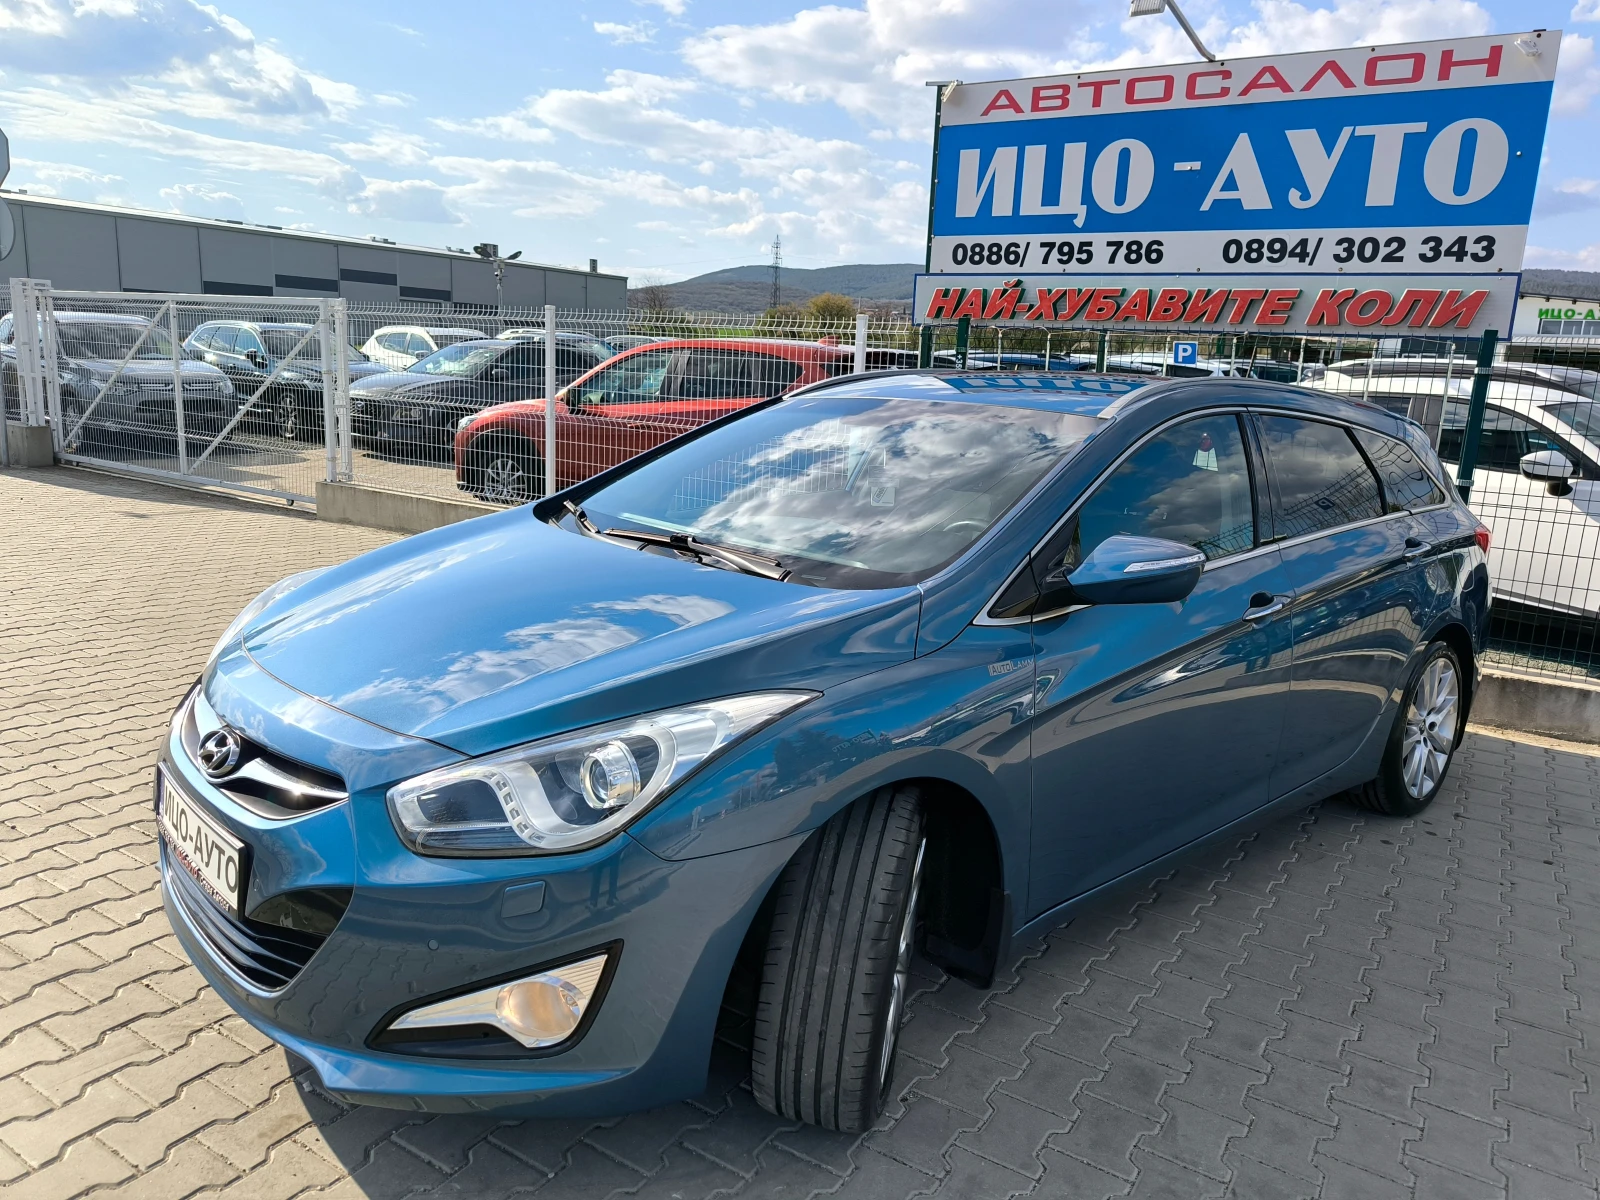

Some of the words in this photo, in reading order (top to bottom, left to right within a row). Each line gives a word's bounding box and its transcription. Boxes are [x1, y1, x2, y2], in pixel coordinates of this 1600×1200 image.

[981, 45, 1503, 117] АВТОСАЛОН
[952, 241, 1030, 267] 0886/
[1039, 241, 1094, 265] 795
[1106, 240, 1164, 264] 786
[1222, 237, 1323, 266] 0894/
[1332, 237, 1406, 263] 302
[1418, 235, 1496, 262] 343
[1304, 288, 1490, 328] КОЛИ
[1538, 308, 1600, 320] ИЦО-А
